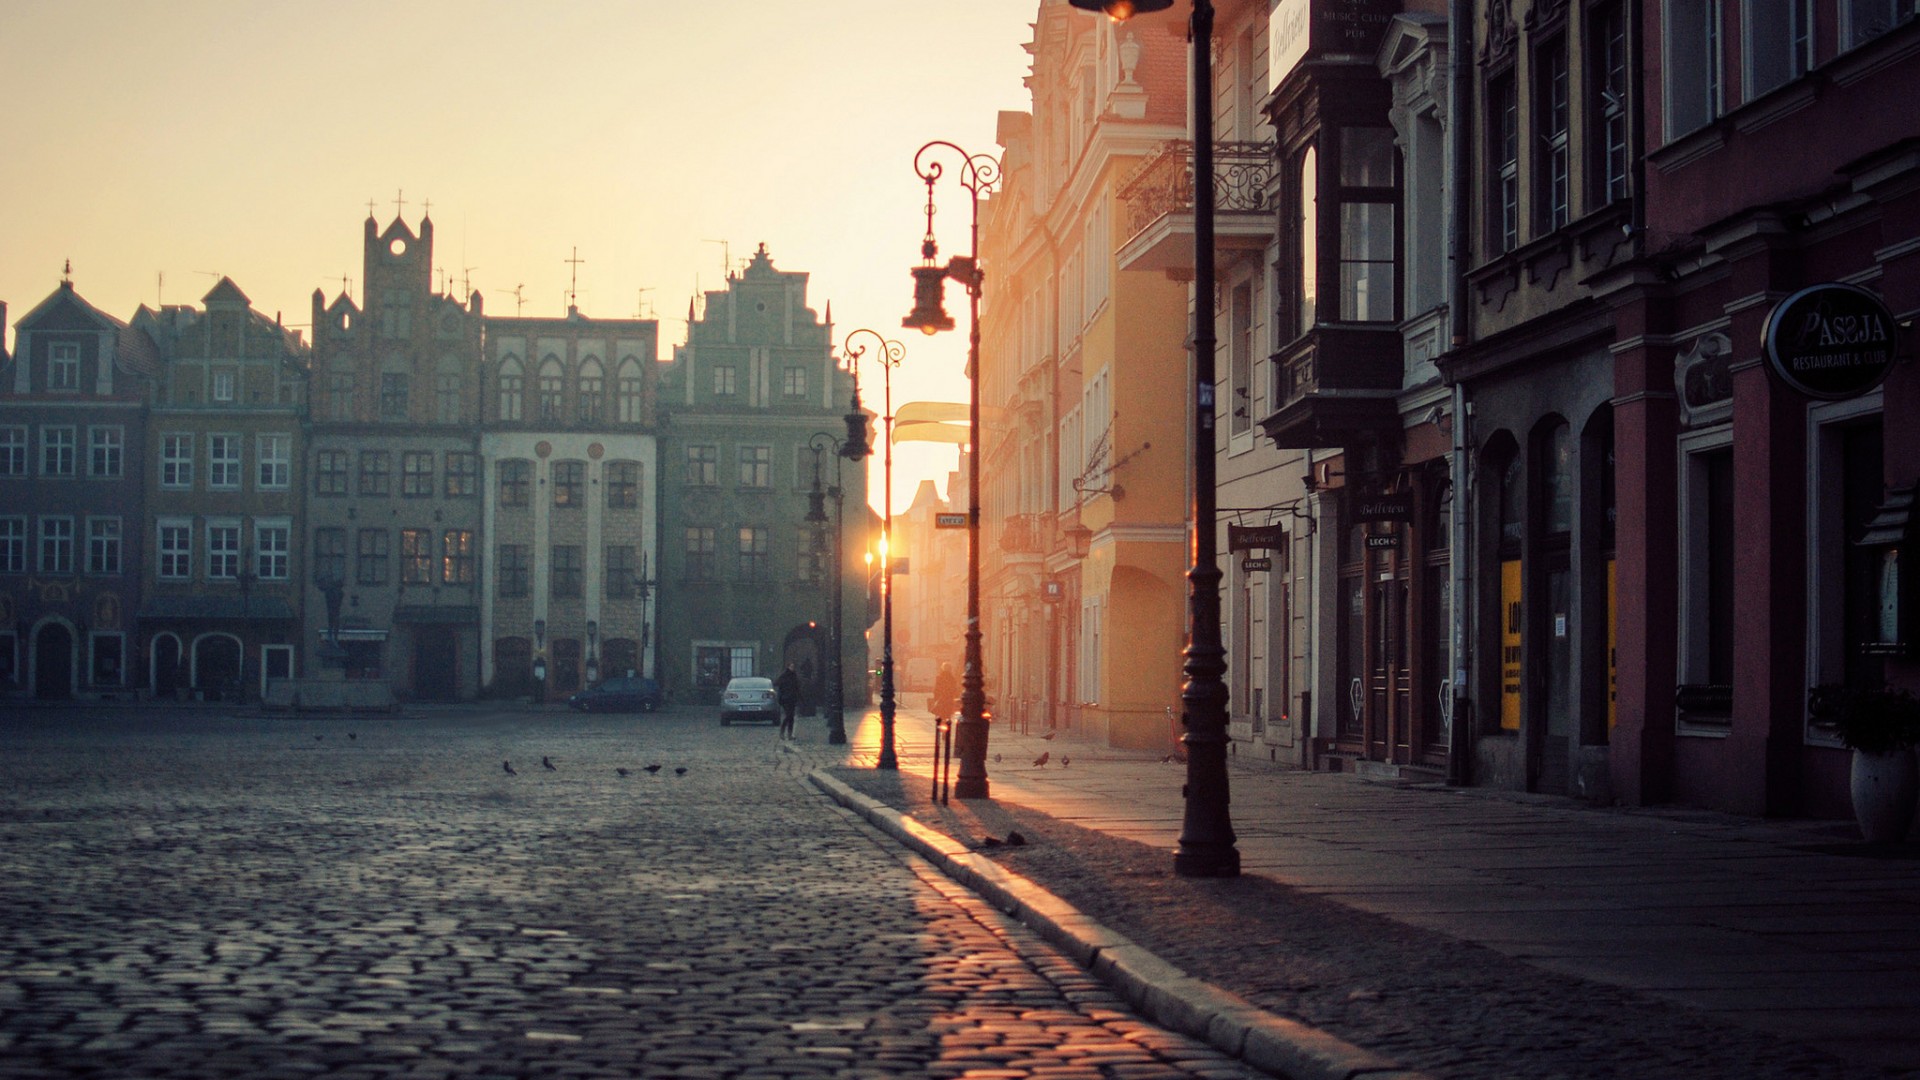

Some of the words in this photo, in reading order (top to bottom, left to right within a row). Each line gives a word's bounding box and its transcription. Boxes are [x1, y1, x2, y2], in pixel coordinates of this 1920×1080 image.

[1323, 11, 1353, 21] MUSIC
[1345, 29, 1367, 38] PUB
[1793, 352, 1851, 371] RESTAURANT
[1854, 353, 1862, 365] &
[1864, 350, 1887, 365] CLUB
[1369, 537, 1390, 546] LECH
